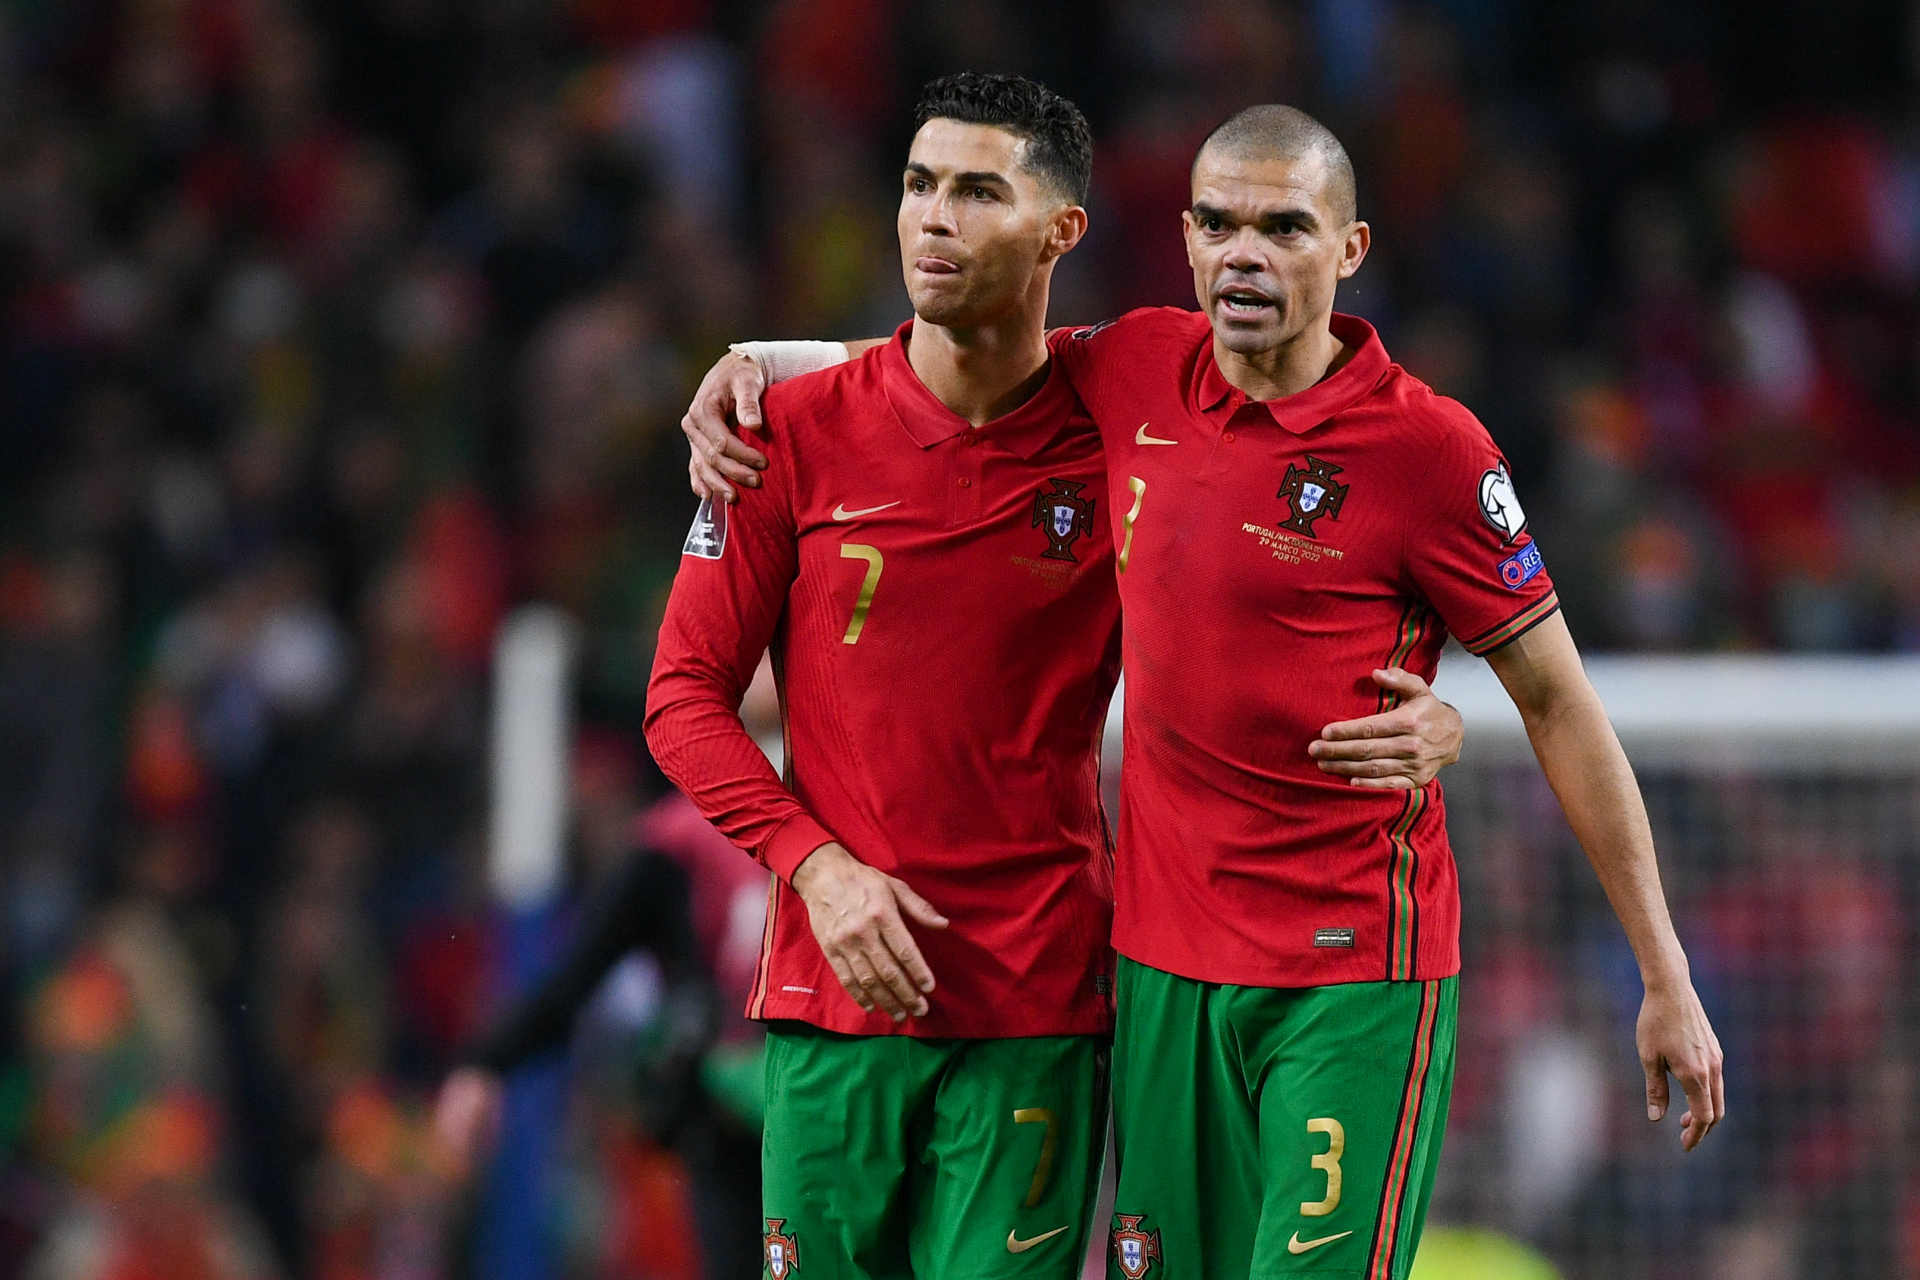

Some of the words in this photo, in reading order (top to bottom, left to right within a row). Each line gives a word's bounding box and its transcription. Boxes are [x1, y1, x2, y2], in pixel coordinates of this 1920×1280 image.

[1259, 537, 1270, 546] 29
[1301, 550, 1321, 562] 2022
[1272, 550, 1301, 565] PORTO
[1322, 547, 1344, 561] NORTE
[840, 543, 884, 644] 7
[1013, 1107, 1059, 1207] 7
[1300, 1117, 1345, 1216] 3
